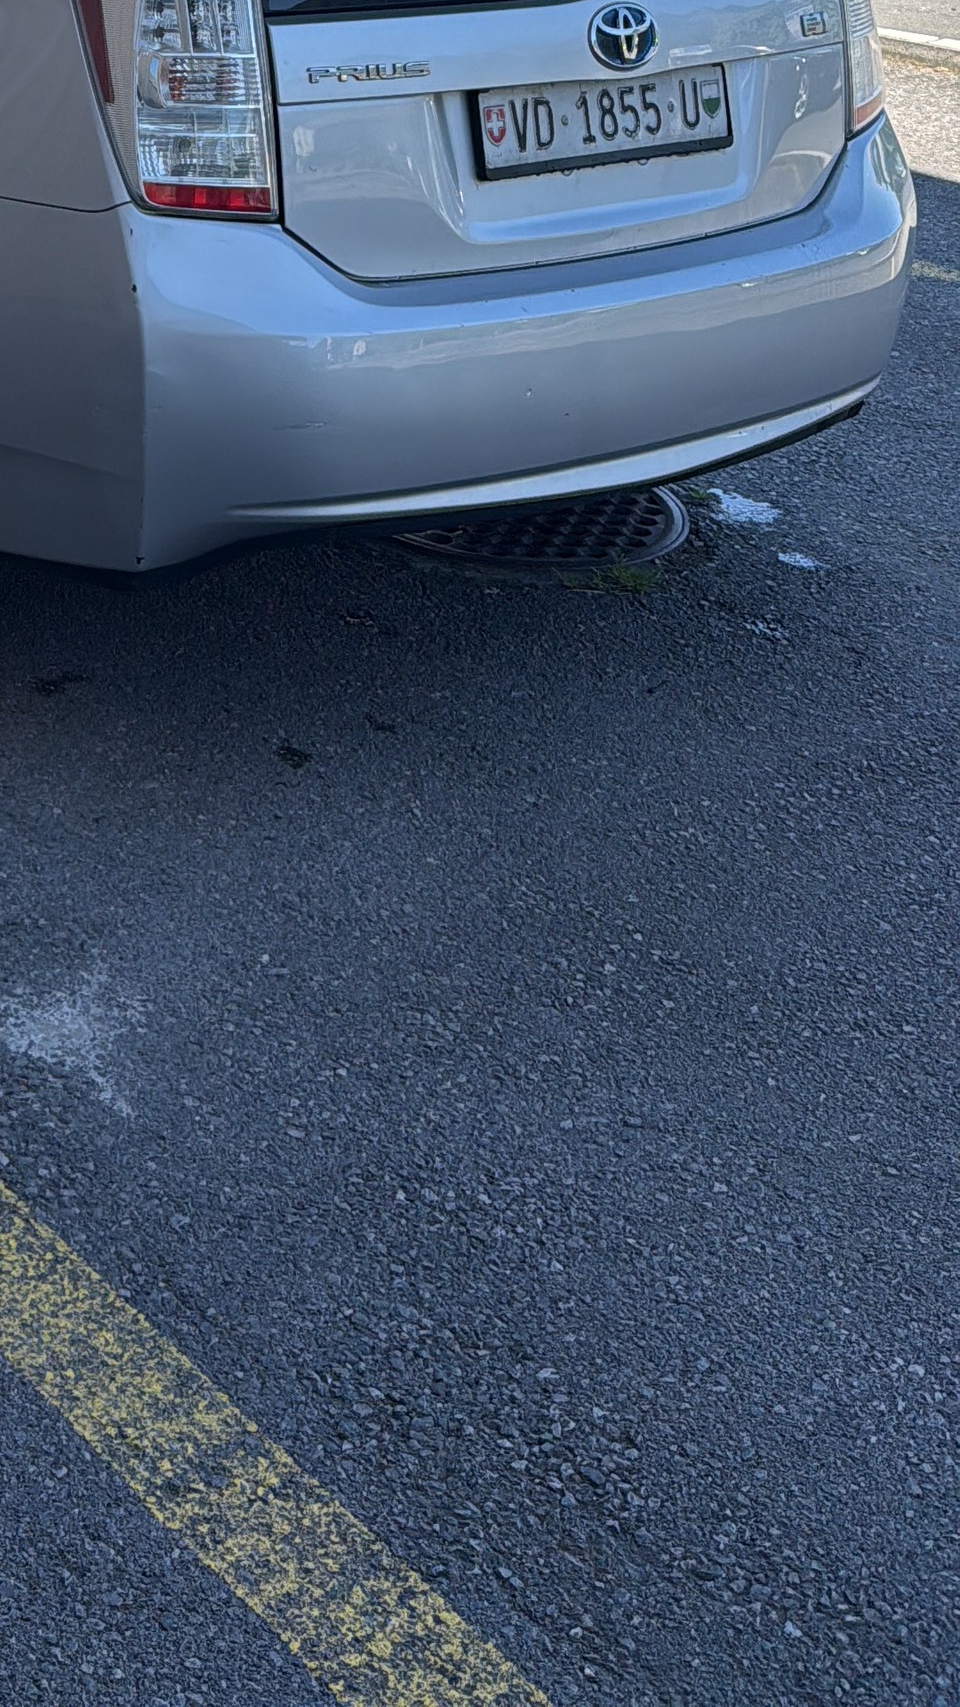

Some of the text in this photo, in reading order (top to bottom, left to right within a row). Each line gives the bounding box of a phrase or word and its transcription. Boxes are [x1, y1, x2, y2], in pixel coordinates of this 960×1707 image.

[306, 60, 431, 84] PRIUS
[508, 96, 555, 153] VD
[575, 82, 663, 146] 1855
